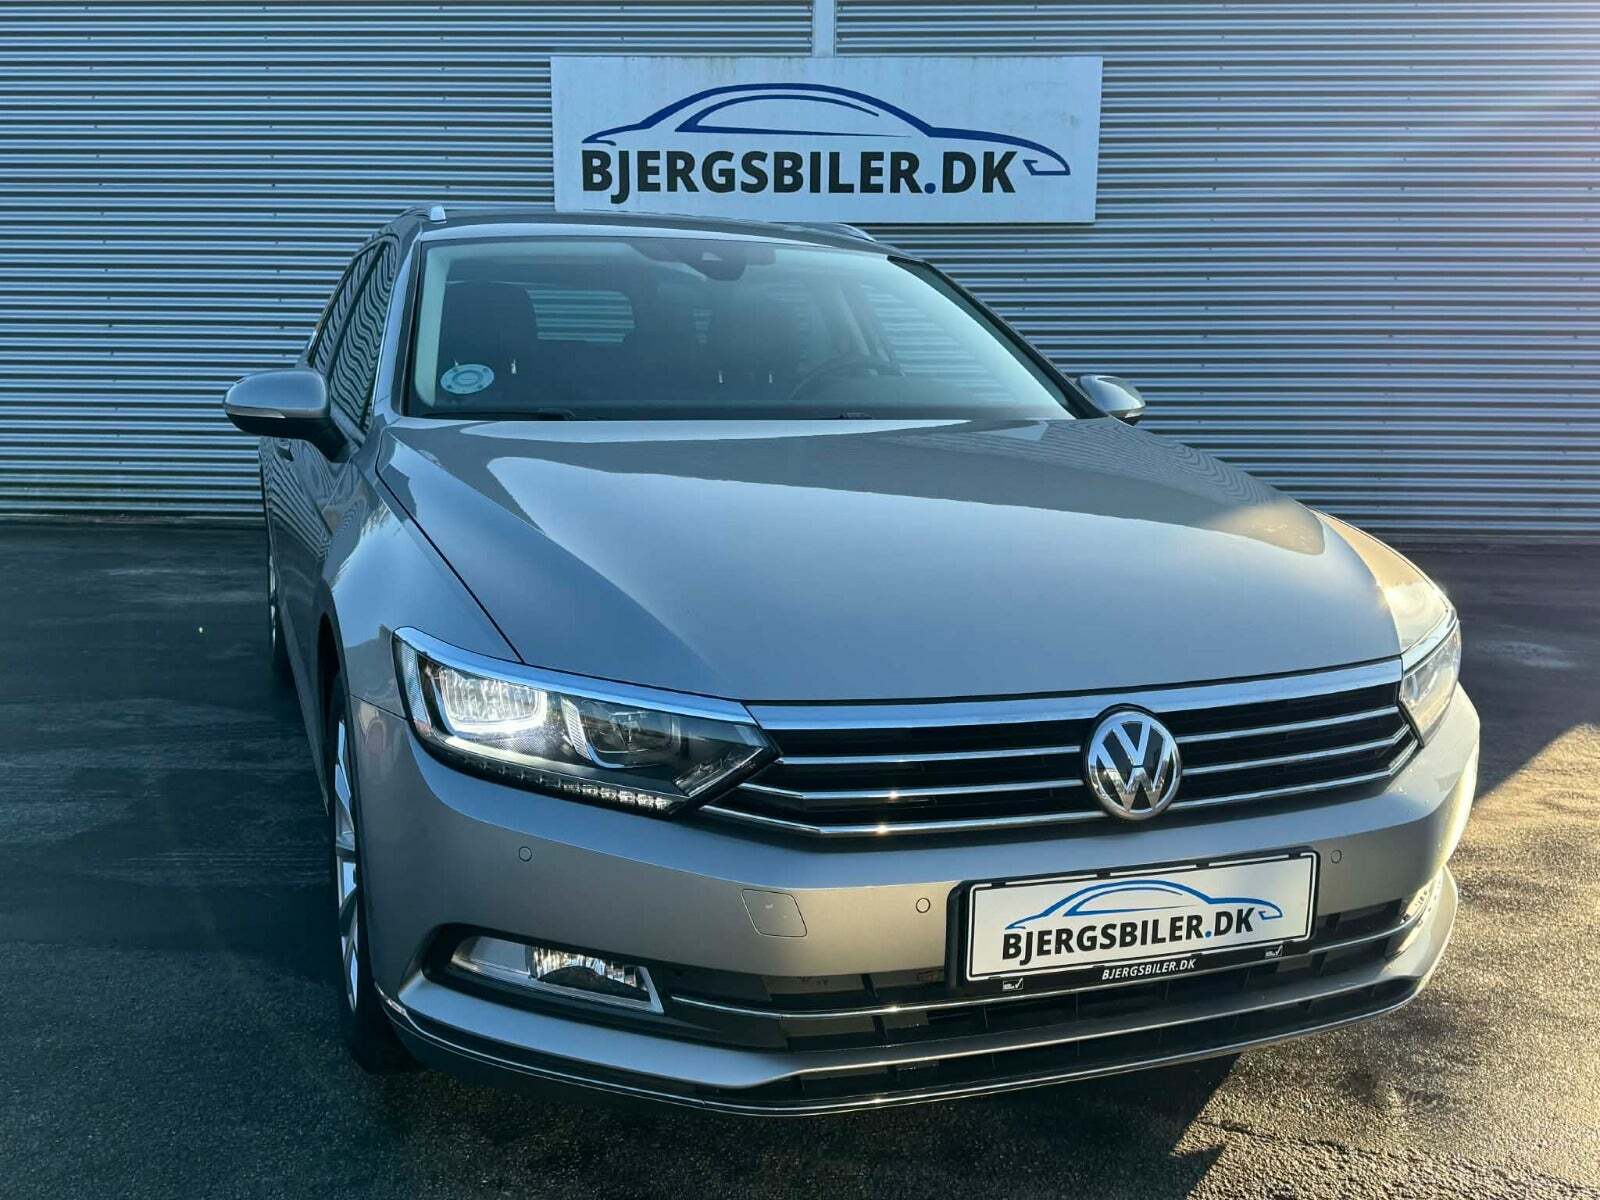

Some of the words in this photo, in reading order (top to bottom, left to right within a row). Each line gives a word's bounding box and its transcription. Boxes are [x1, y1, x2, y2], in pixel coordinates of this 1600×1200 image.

[582, 150, 1016, 203] BJERGSBILER.DK
[1002, 907, 1255, 965] BJERGSBILER.DK
[1102, 958, 1197, 980] BJERGSBILER.DK
